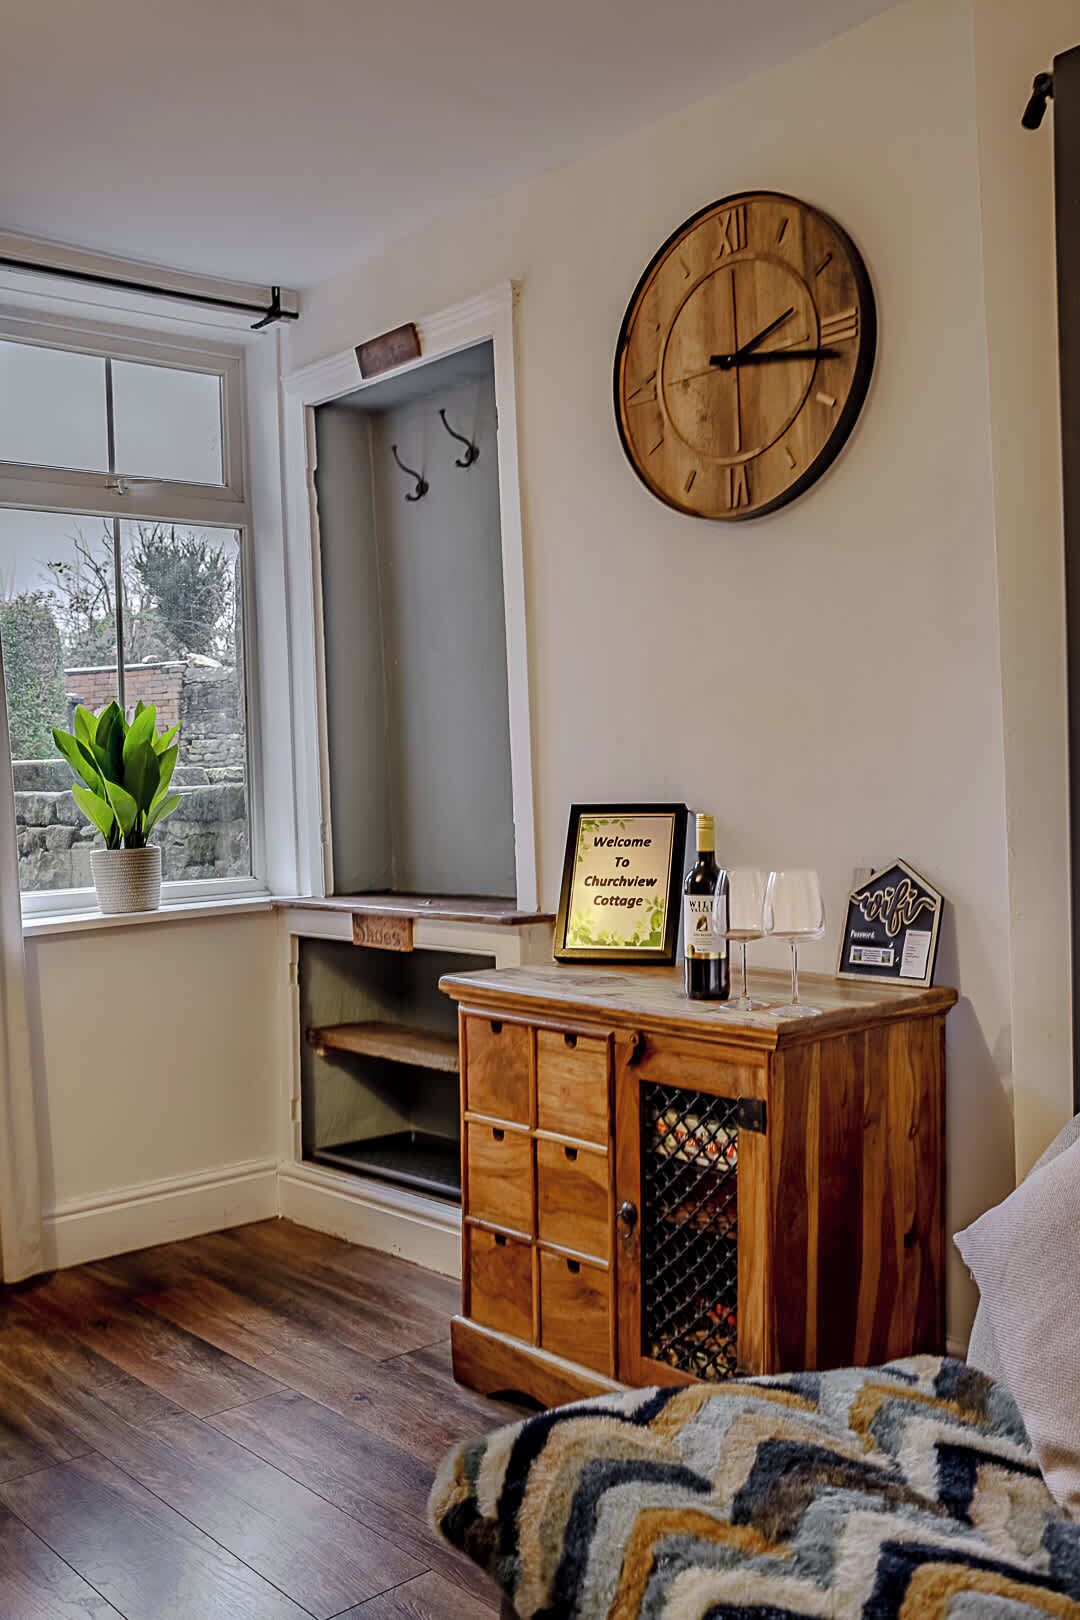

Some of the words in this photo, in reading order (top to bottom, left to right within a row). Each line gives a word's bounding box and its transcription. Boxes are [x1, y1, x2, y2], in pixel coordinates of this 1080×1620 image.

[593, 837, 652, 848] Welcome
[614, 856, 630, 868] To
[583, 875, 658, 888] Churchview
[593, 895, 644, 909] Cottage
